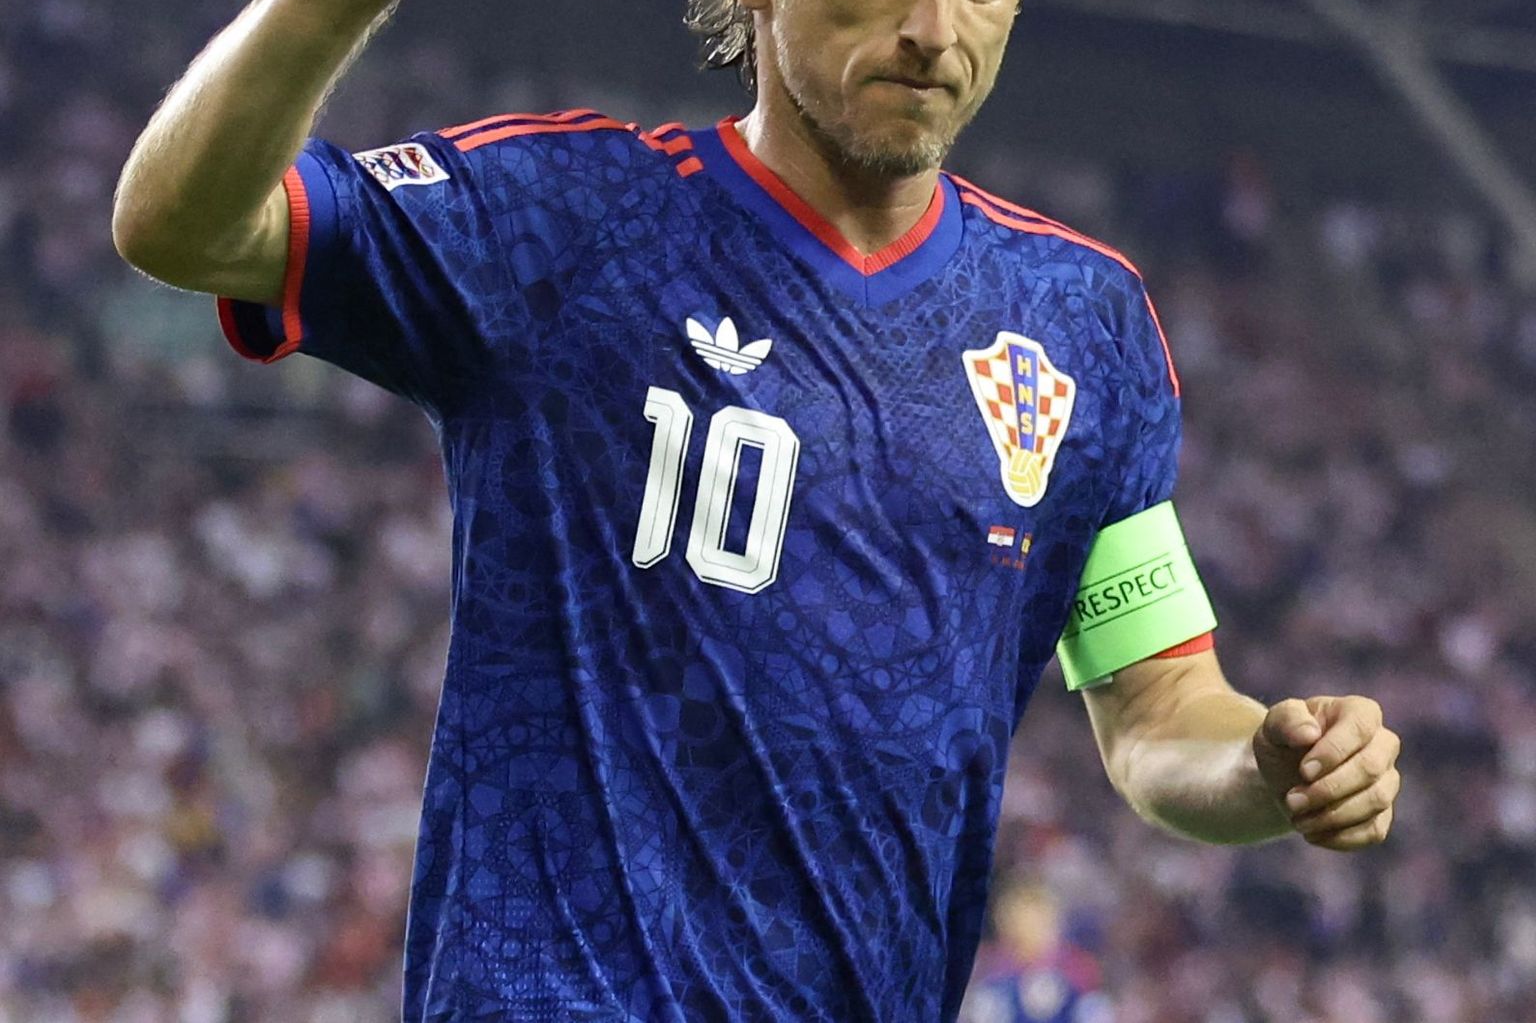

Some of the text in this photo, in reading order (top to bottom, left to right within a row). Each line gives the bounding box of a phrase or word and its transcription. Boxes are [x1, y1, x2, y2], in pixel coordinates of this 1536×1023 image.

[1016, 354, 1034, 436] HNS
[631, 385, 801, 595] 10
[1073, 561, 1177, 623] RESPECT
